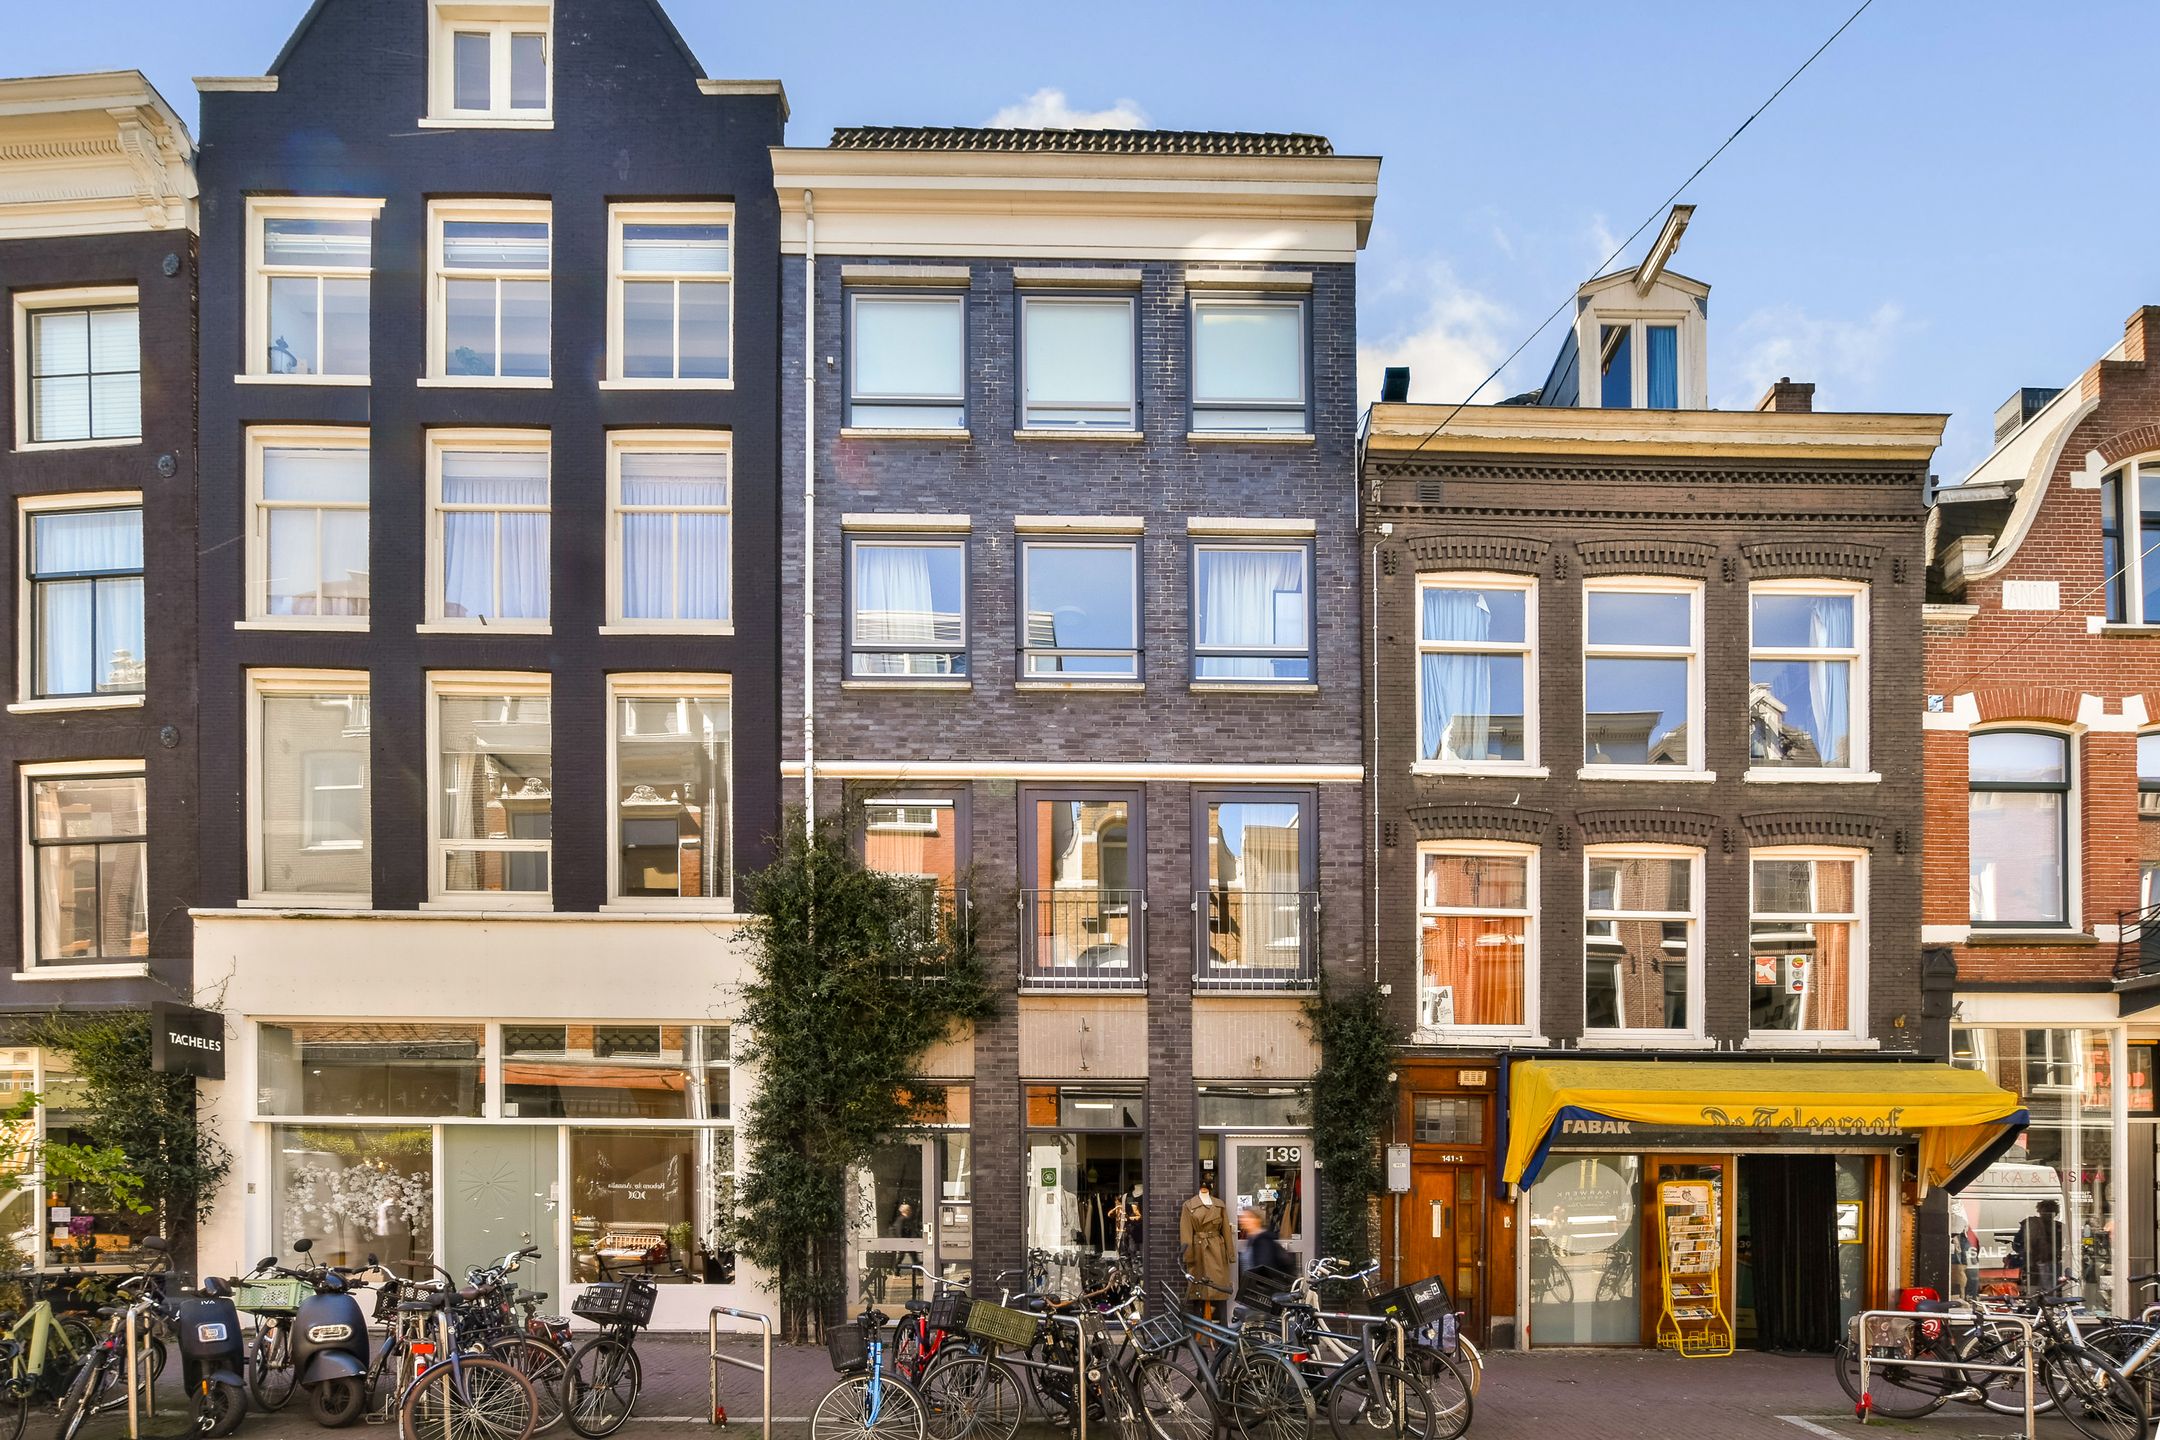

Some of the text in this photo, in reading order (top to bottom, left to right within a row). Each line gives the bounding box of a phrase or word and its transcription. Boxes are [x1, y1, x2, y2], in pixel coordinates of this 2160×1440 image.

[2007, 584, 2056, 607] ANNO
[169, 1032, 221, 1052] TACHELES
[1266, 1147, 1301, 1162] 139
[1967, 1246, 2007, 1258] SALE
